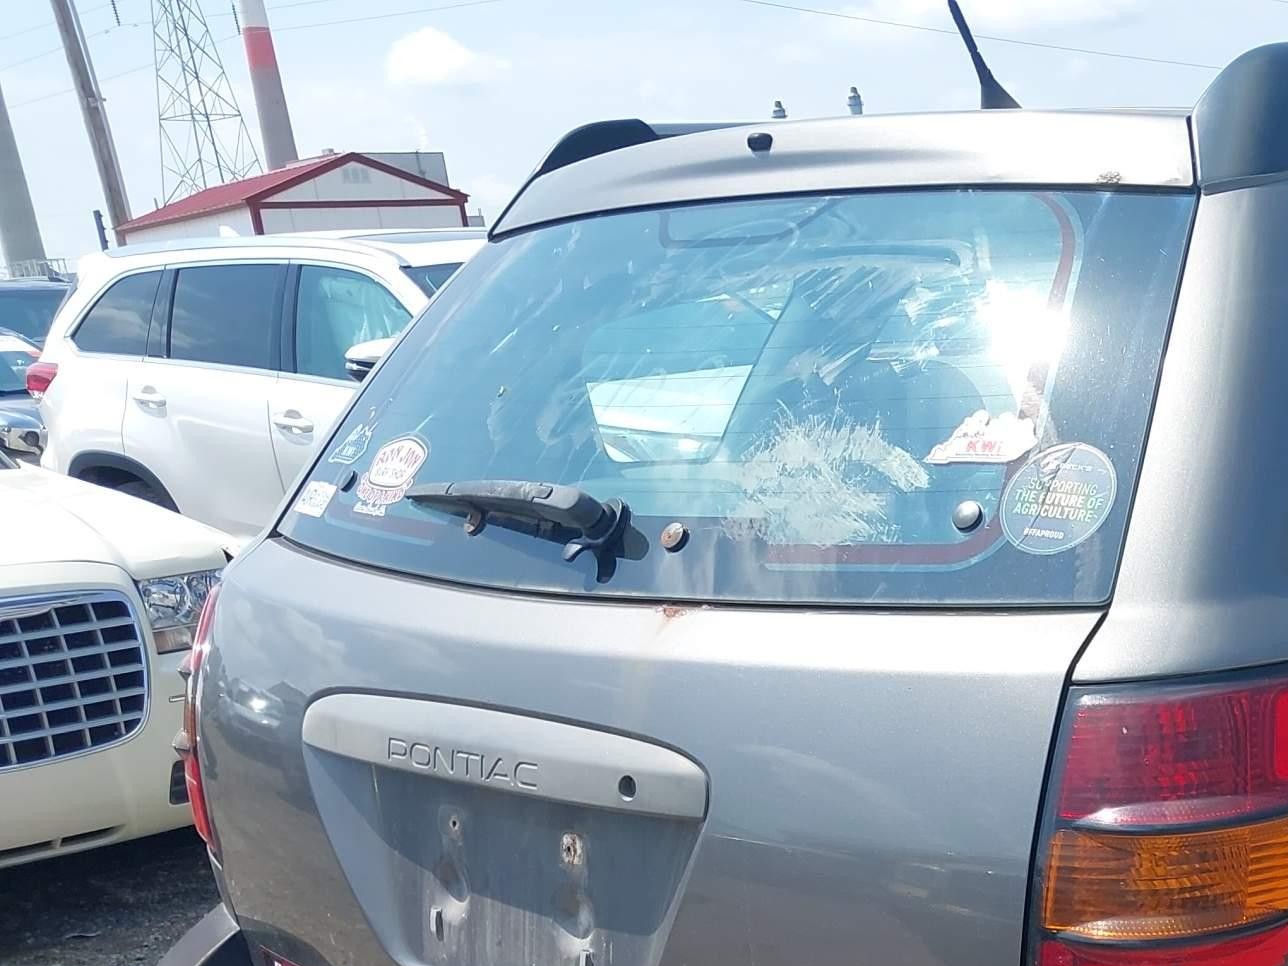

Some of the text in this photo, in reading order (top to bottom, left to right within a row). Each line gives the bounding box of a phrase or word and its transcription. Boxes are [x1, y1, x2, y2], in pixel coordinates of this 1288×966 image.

[1028, 477, 1098, 496] SUPPORTING
[1015, 489, 1105, 510] THE FUTURE OF
[1013, 502, 1093, 523] AGRICULTURE
[386, 735, 540, 791] PONTIAC
